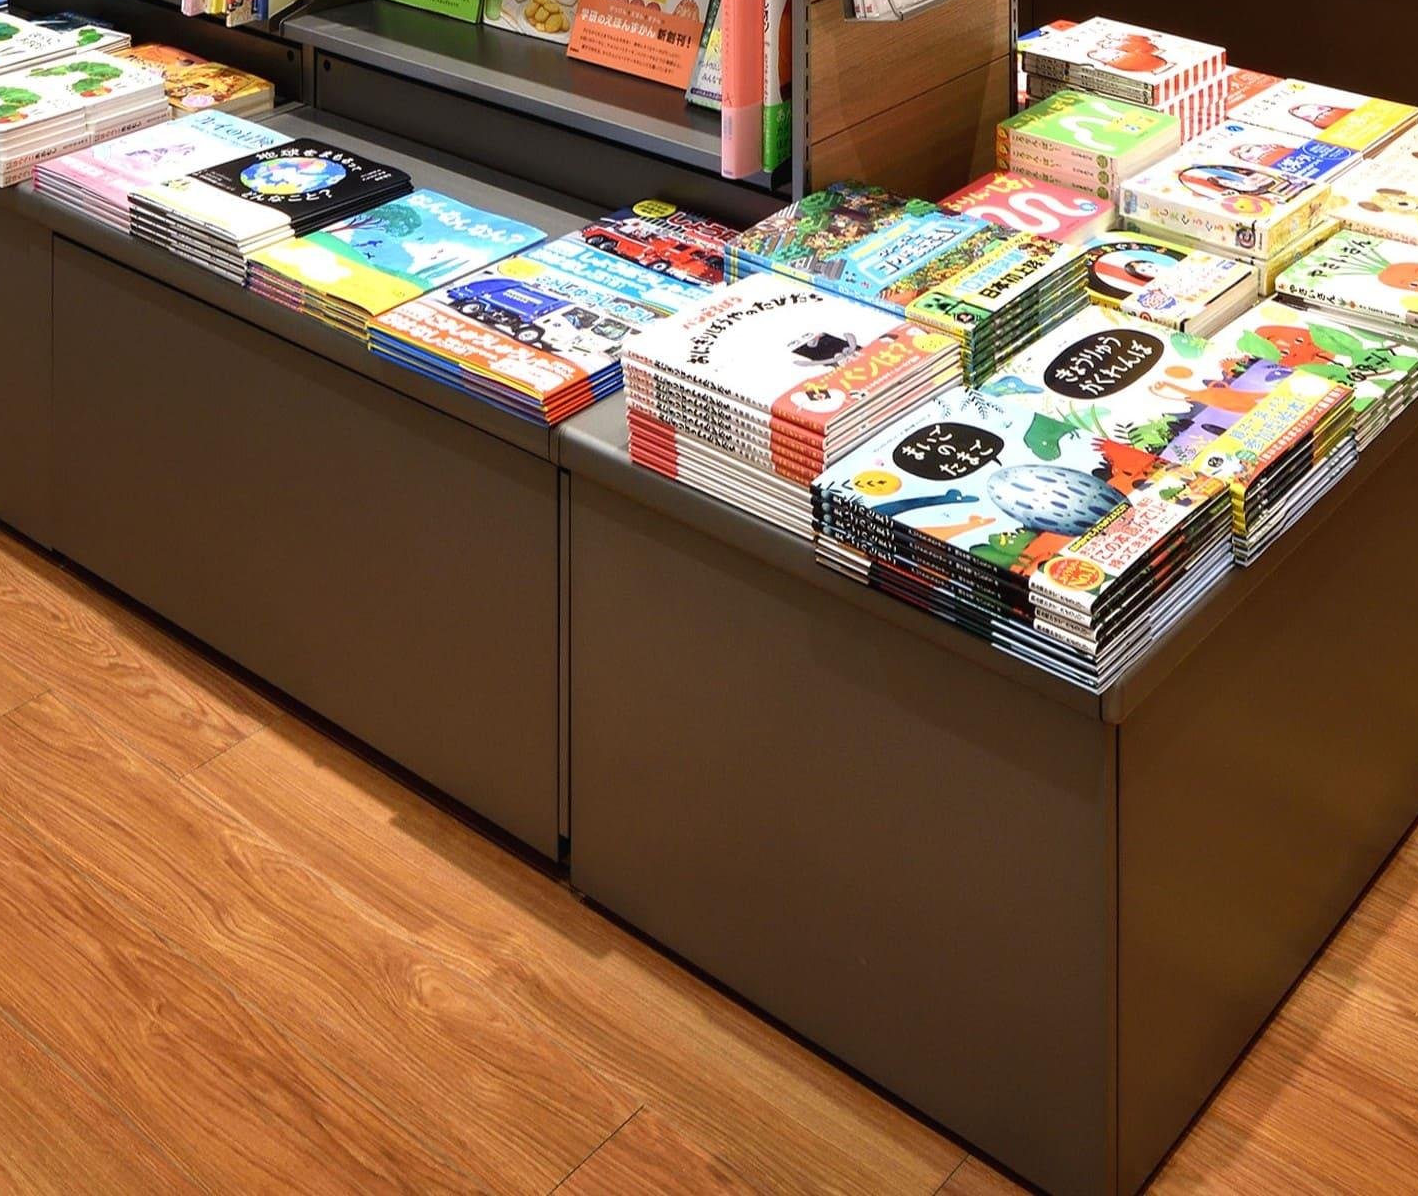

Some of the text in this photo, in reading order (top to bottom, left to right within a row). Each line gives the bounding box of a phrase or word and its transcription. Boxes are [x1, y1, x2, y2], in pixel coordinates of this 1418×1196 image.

[656, 26, 694, 52] 新創刊!
[979, 257, 1046, 300] 日本初上陸
[1289, 284, 1338, 305] やさいさん
[1053, 333, 1124, 383] きょうりゅう
[1078, 340, 1156, 399] かくれんぼ
